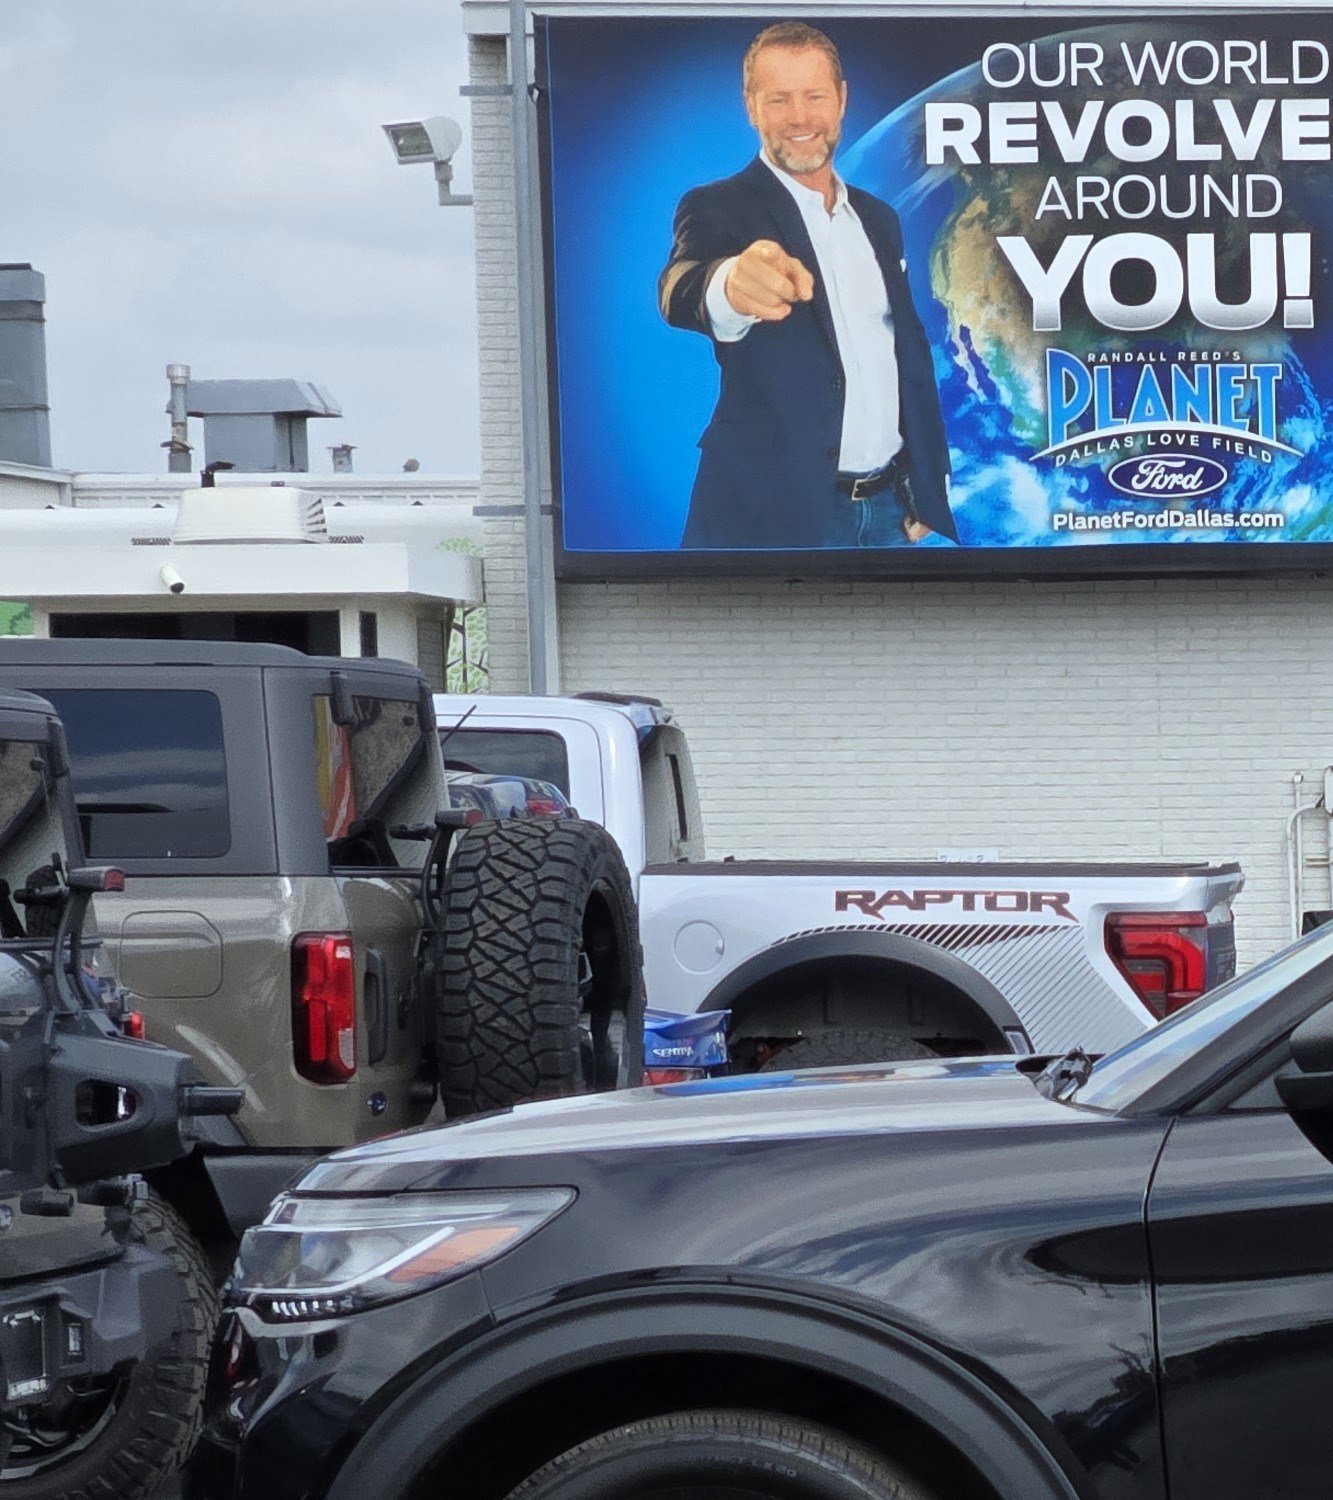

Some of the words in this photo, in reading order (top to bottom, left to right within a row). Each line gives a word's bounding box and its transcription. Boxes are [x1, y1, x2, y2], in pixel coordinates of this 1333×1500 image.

[981, 42, 1103, 88] OUR
[1121, 40, 1330, 86] WORLD
[1035, 174, 1283, 219] AROUND
[996, 231, 1315, 332] YOU!
[1087, 352, 1167, 363] RANDALL
[1178, 351, 1241, 361] REED'S
[1046, 348, 1282, 448] PLANET
[1055, 435, 1134, 467] DALLAS
[1146, 433, 1200, 447] LOVE
[1212, 437, 1272, 463] FIELD
[1131, 459, 1204, 490] Ford
[1053, 509, 1285, 531] PlanetFordDallas.com
[835, 889, 1079, 923] RAPTOR
